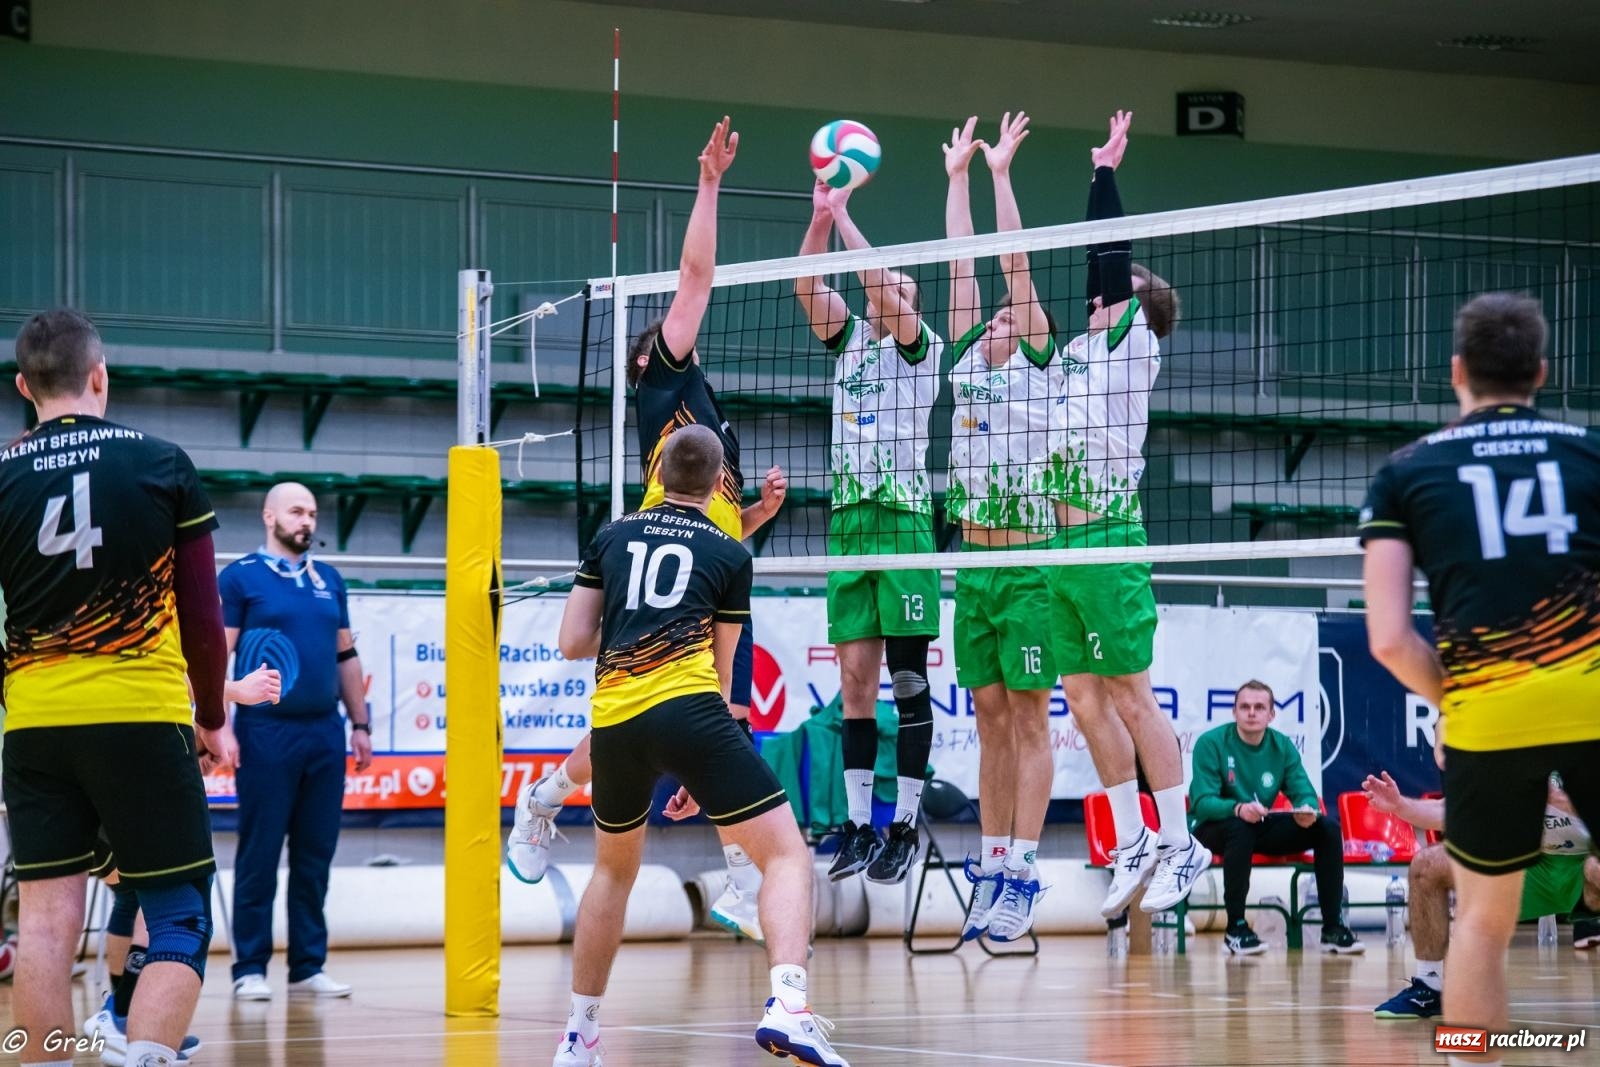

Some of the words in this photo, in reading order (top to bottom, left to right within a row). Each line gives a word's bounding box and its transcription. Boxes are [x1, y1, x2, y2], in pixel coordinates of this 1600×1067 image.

[1188, 107, 1225, 130] D
[50, 428, 144, 449] SFERAWENT
[33, 446, 100, 472] CIESZYN
[37, 471, 103, 570] 4
[1457, 460, 1578, 560] 14
[622, 512, 661, 522] TALENT
[661, 515, 731, 540] SFERAWENT
[643, 525, 694, 539] CIESZYN
[625, 541, 694, 610] 10
[902, 594, 924, 621] 13
[416, 643, 446, 662] Biu
[499, 644, 594, 662] Racibo
[1088, 632, 1103, 660] 2
[1021, 646, 1041, 674] 16
[563, 679, 587, 697] 69
[505, 710, 587, 729] kiewicza
[1544, 816, 1572, 830] EAM
